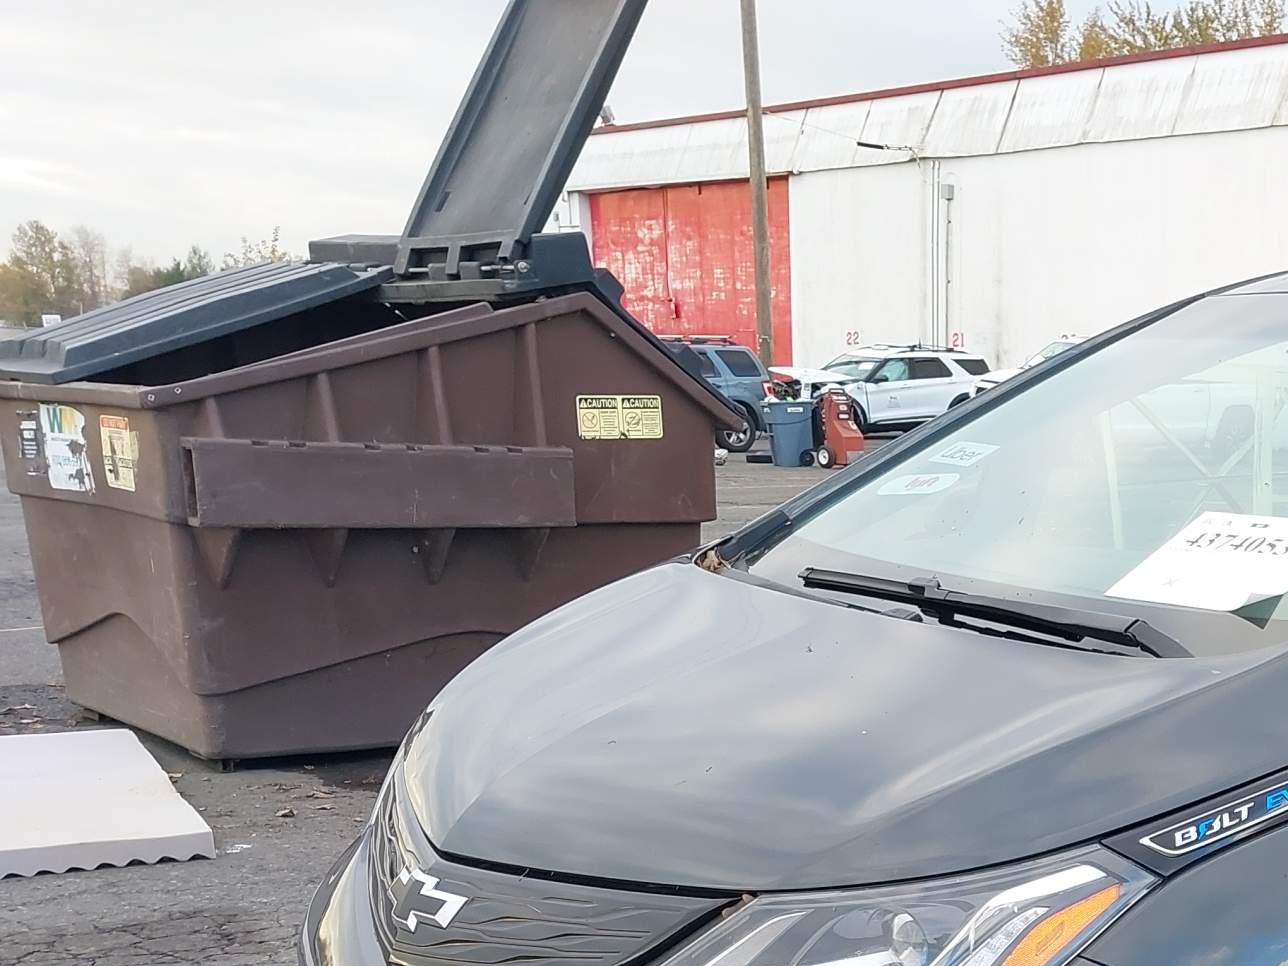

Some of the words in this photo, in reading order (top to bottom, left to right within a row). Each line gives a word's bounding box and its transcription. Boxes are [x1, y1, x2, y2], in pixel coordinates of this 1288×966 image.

[846, 331, 860, 345] 22
[952, 332, 965, 348] 21
[586, 398, 618, 408] CAUTION
[628, 398, 660, 408] CAUTION
[1174, 801, 1255, 848] BOLT
